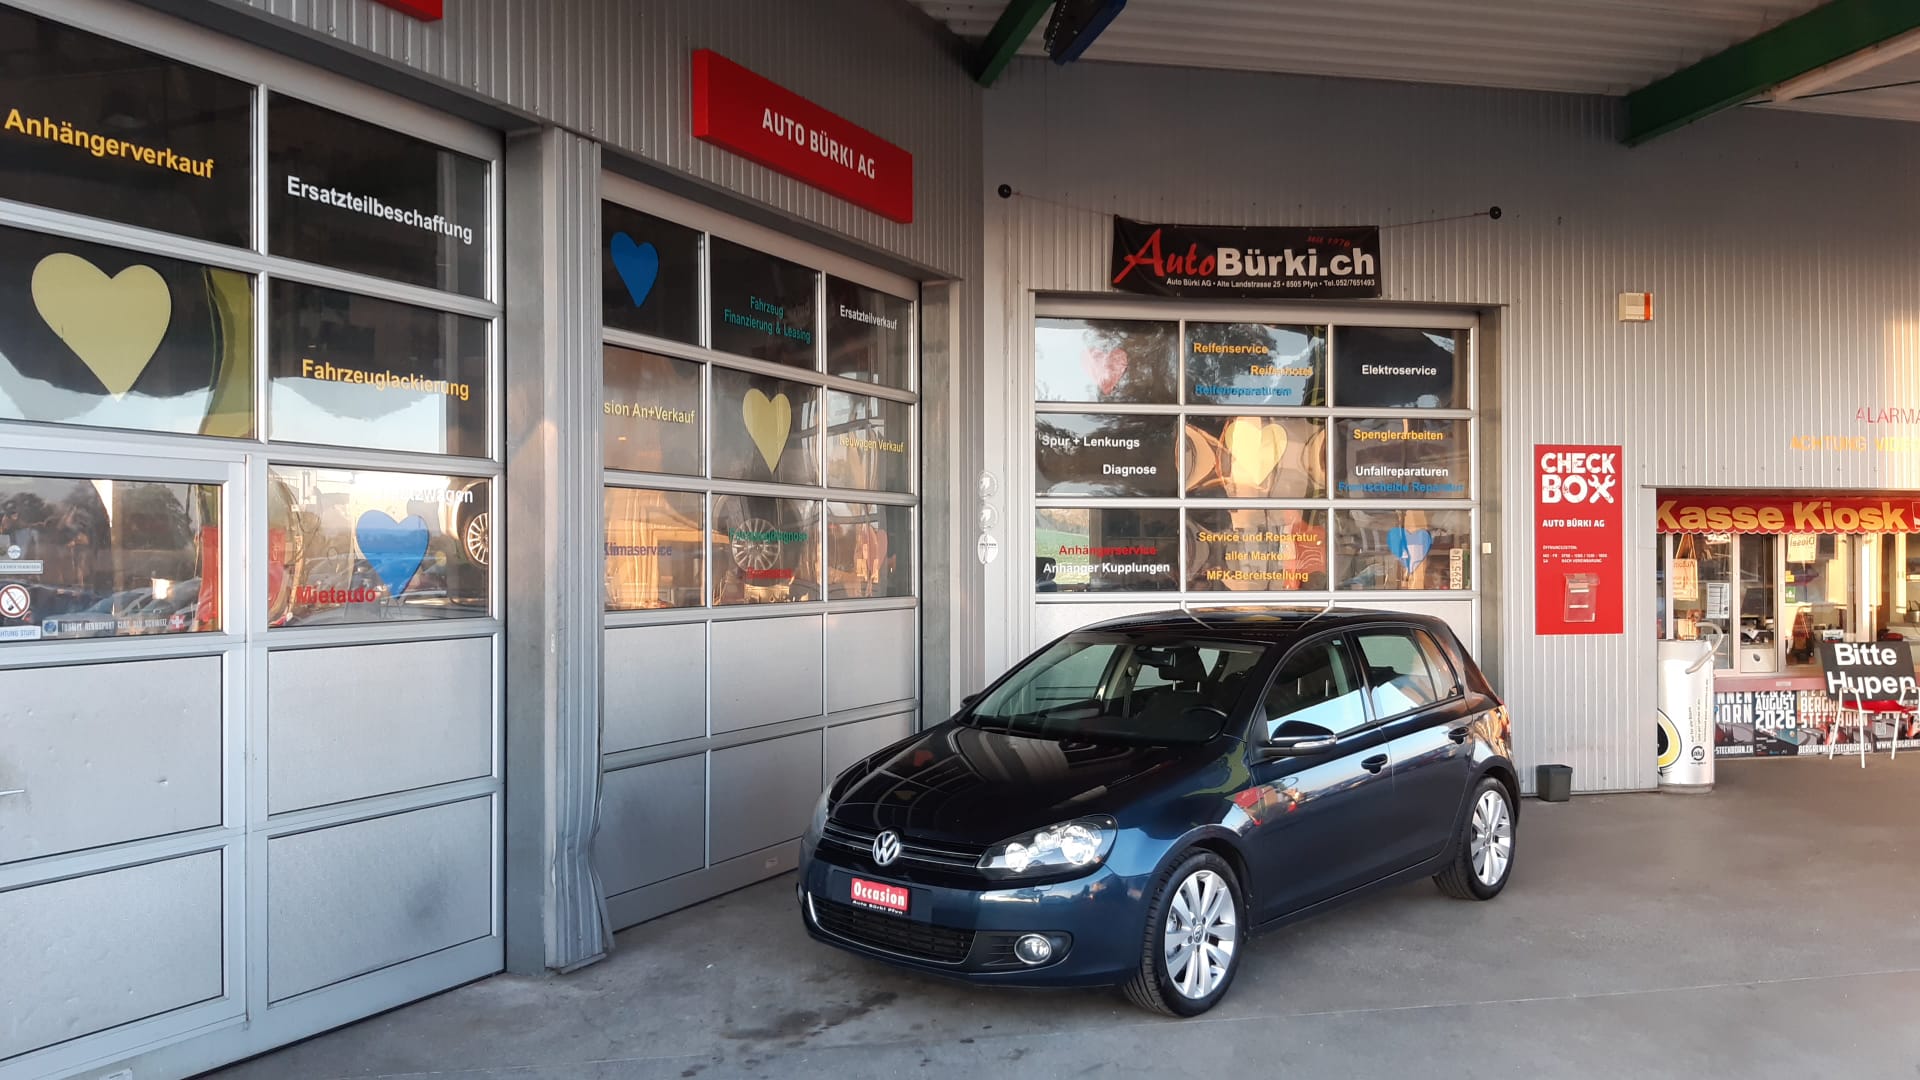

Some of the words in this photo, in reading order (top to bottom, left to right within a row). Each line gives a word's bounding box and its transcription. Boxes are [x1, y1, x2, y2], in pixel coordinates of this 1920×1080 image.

[4, 108, 214, 179] Anhängerverkauf
[762, 108, 805, 146] AUTO
[810, 129, 853, 170] BÜRKI
[857, 153, 875, 179] AG
[287, 175, 473, 244] Ersatzteilbeschaffung
[1166, 278, 1182, 286] Auto
[1183, 278, 1200, 287] Bürki
[1231, 280, 1272, 288] Landstrasse
[1302, 280, 1318, 289] Pfyn
[750, 295, 784, 319] Fahrzeug
[724, 308, 773, 336] Finanzierung
[784, 323, 811, 344] Leasing
[840, 305, 897, 330] Ersatzteilverkauf
[1194, 342, 1269, 354] Reifenservice
[1362, 365, 1437, 376] Elektroservice
[301, 358, 470, 402] Fahrzeuglackierung
[1042, 435, 1070, 448] Spur
[1083, 436, 1140, 449] Lenkungs
[1353, 429, 1443, 442] Spenglerarbeiten
[1790, 435, 1867, 452] ACHTUNG
[879, 439, 904, 453] Verkauf
[1102, 464, 1157, 477] Diagnose
[1541, 452, 1616, 474] CHECK
[1355, 466, 1448, 479] Unfallreparaturen
[1541, 474, 1616, 504] BOX
[1542, 519, 1565, 528] AUTO
[1566, 517, 1592, 528] BÜRKI
[1593, 519, 1605, 528] AG
[1657, 500, 1785, 529] Kasse
[1793, 501, 1906, 530] Kiosk
[1199, 532, 1239, 542] Service
[1243, 532, 1262, 542] und
[1225, 551, 1248, 561] aller
[1043, 562, 1099, 575] Anhänger
[1102, 562, 1170, 575] Kupplungen
[1206, 570, 1309, 582] MFK-Bereitstellung
[296, 586, 376, 604] Mietauto
[1834, 643, 1897, 666] Bitte
[1826, 671, 1916, 699] Hupen
[1755, 698, 1795, 710] AUGUST
[1755, 710, 1795, 729] 2026
[854, 881, 905, 907] Occasion
